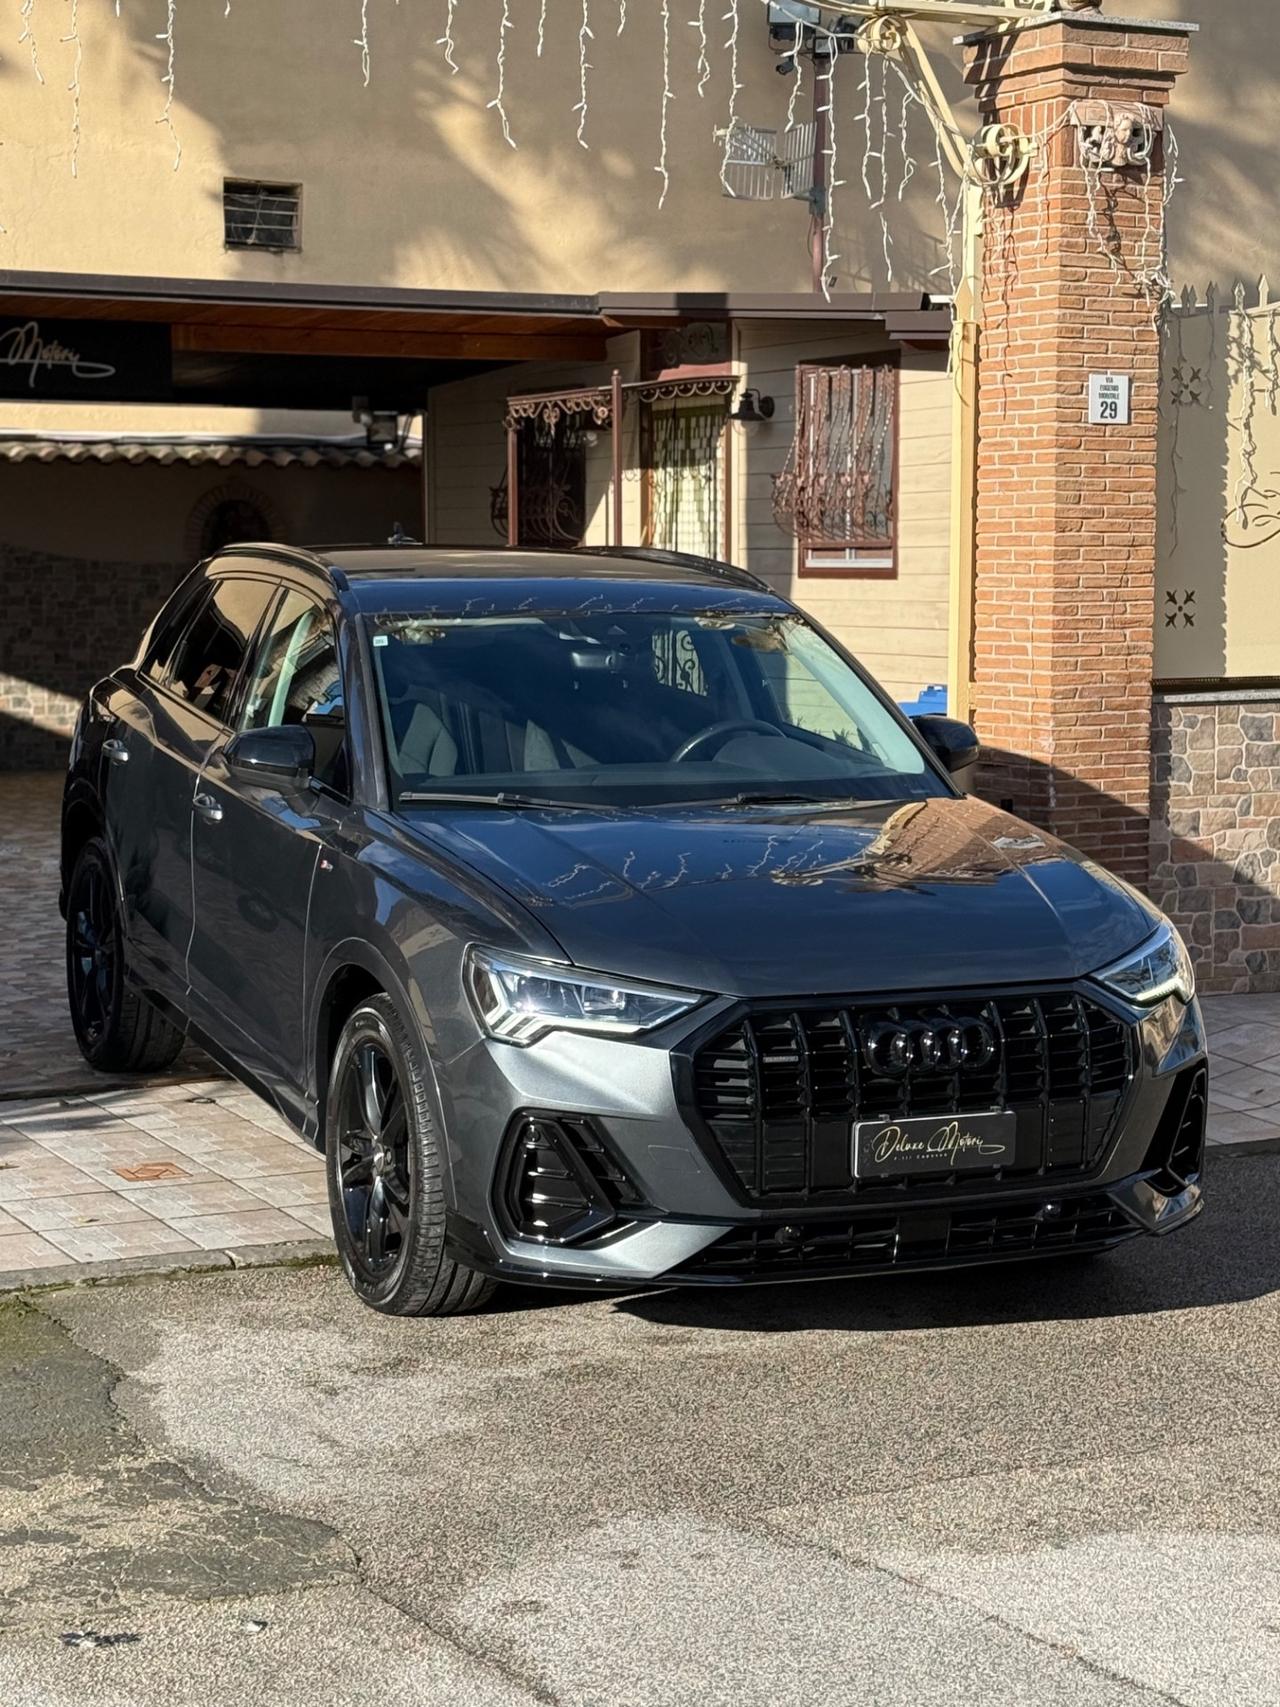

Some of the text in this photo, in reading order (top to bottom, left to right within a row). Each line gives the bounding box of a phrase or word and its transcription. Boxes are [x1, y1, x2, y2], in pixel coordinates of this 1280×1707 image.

[1100, 401, 1118, 419] 29
[872, 1126, 924, 1163] Deluxe
[926, 1121, 1006, 1165] Motori
